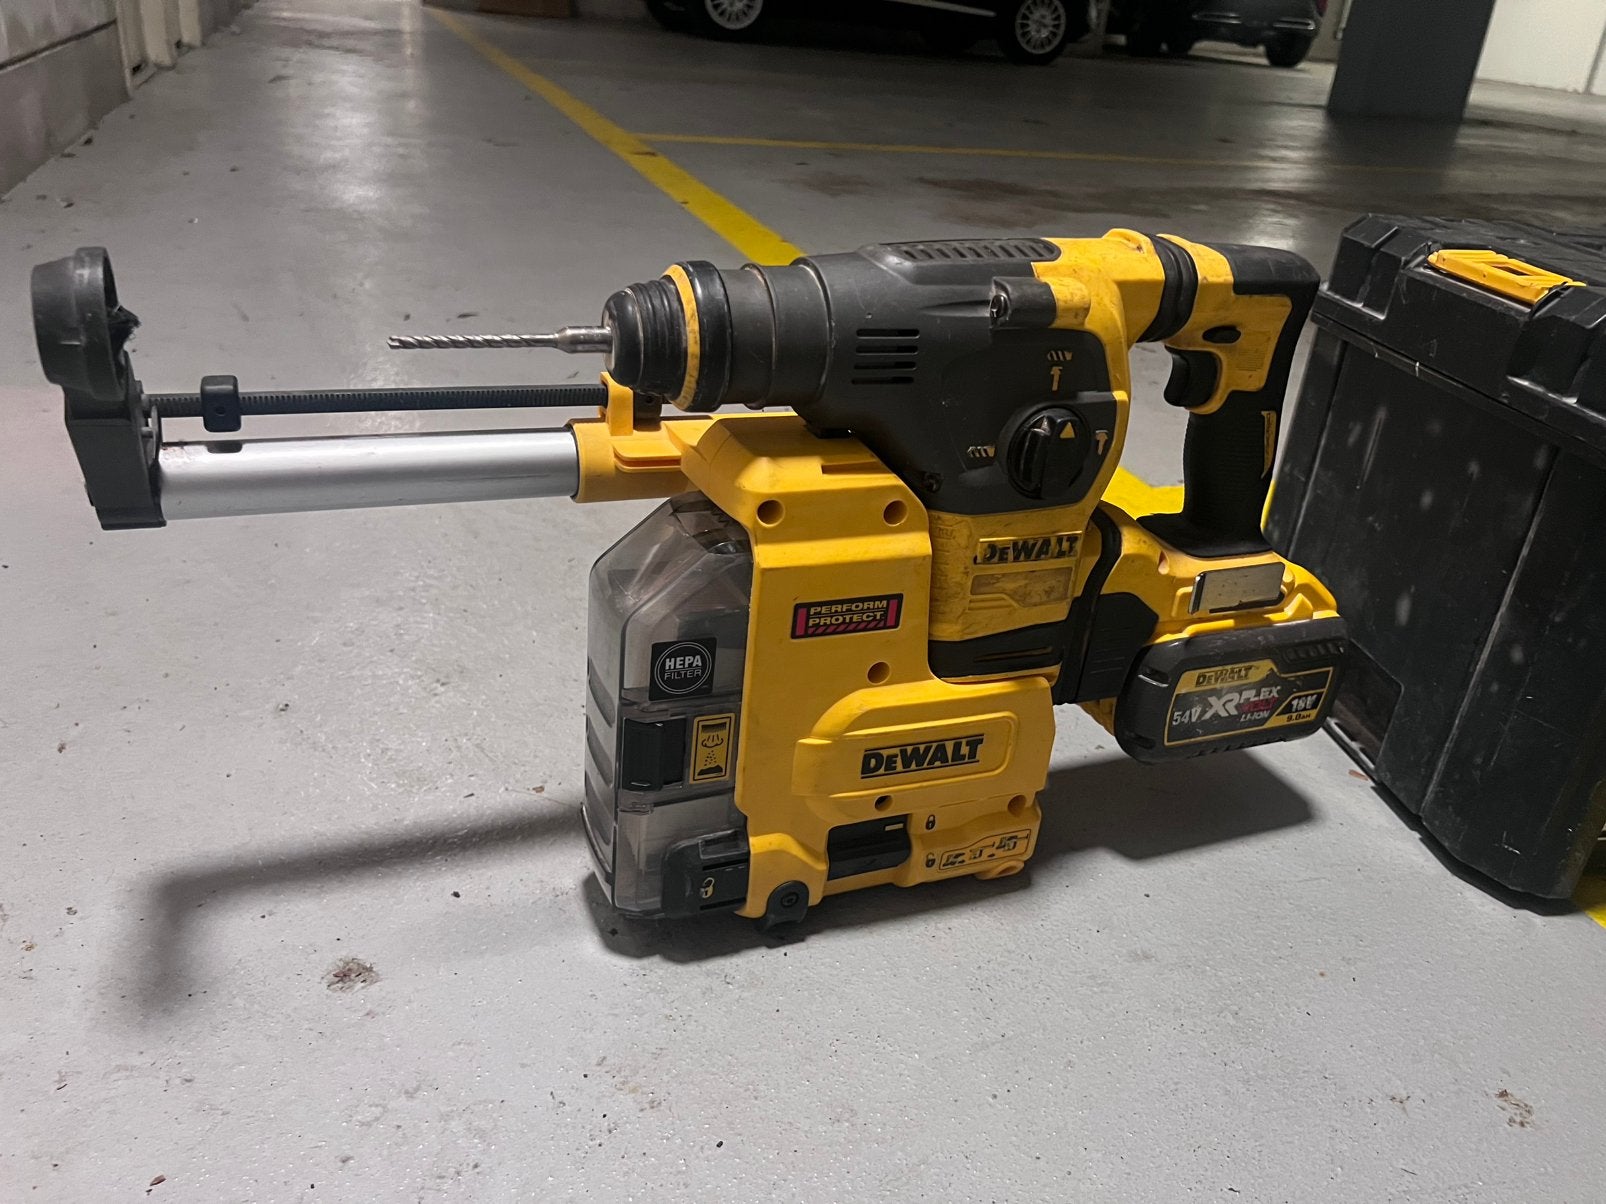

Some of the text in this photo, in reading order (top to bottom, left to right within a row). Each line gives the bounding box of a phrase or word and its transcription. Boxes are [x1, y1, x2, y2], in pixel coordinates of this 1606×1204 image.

[810, 600, 888, 615] PERFORM
[665, 655, 702, 670] HEPA
[664, 669, 702, 680] FILTER
[1172, 686, 1281, 726] 54V XR FLEX
[1291, 694, 1318, 712] 18V
